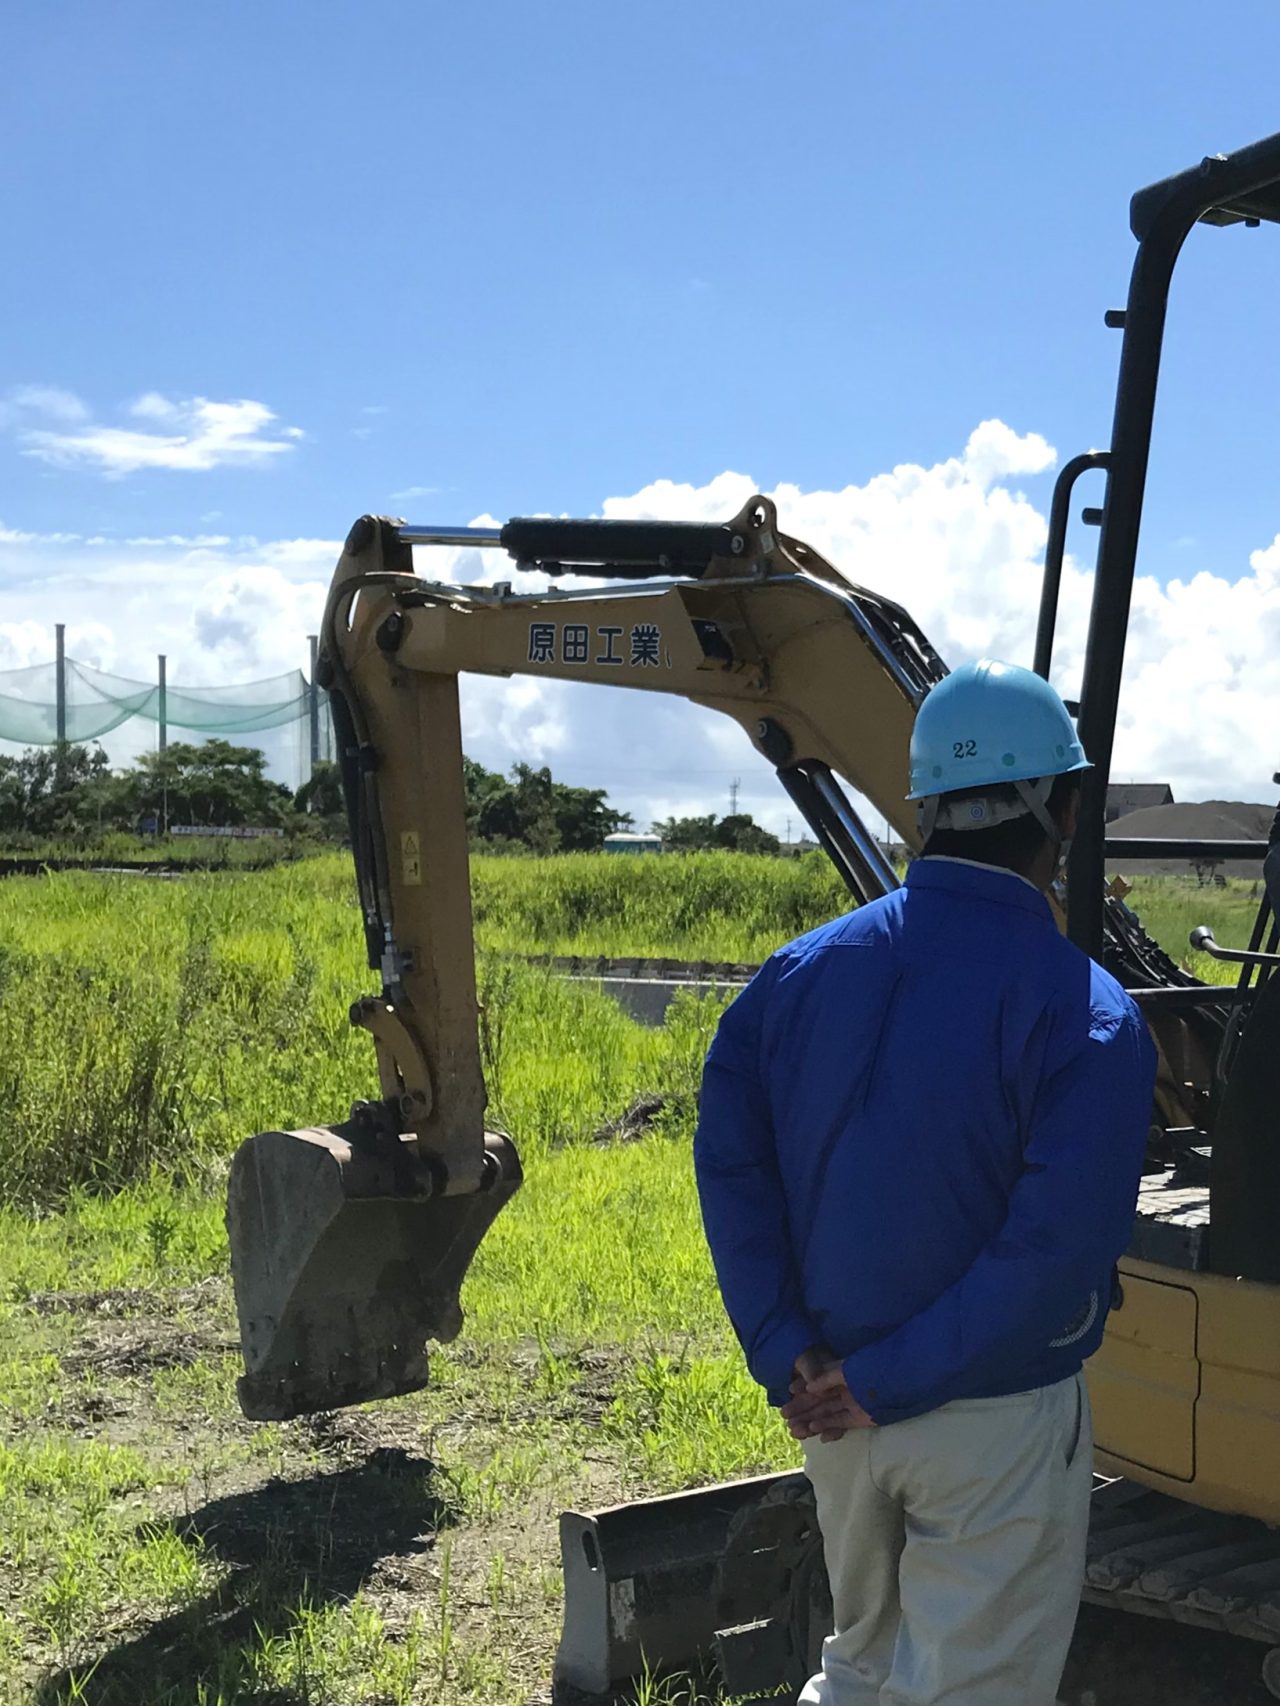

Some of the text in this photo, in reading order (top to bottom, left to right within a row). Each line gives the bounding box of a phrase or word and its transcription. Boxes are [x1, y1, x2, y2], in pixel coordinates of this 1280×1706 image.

[528, 622, 661, 668] 原田工業
[953, 739, 977, 759] 22
